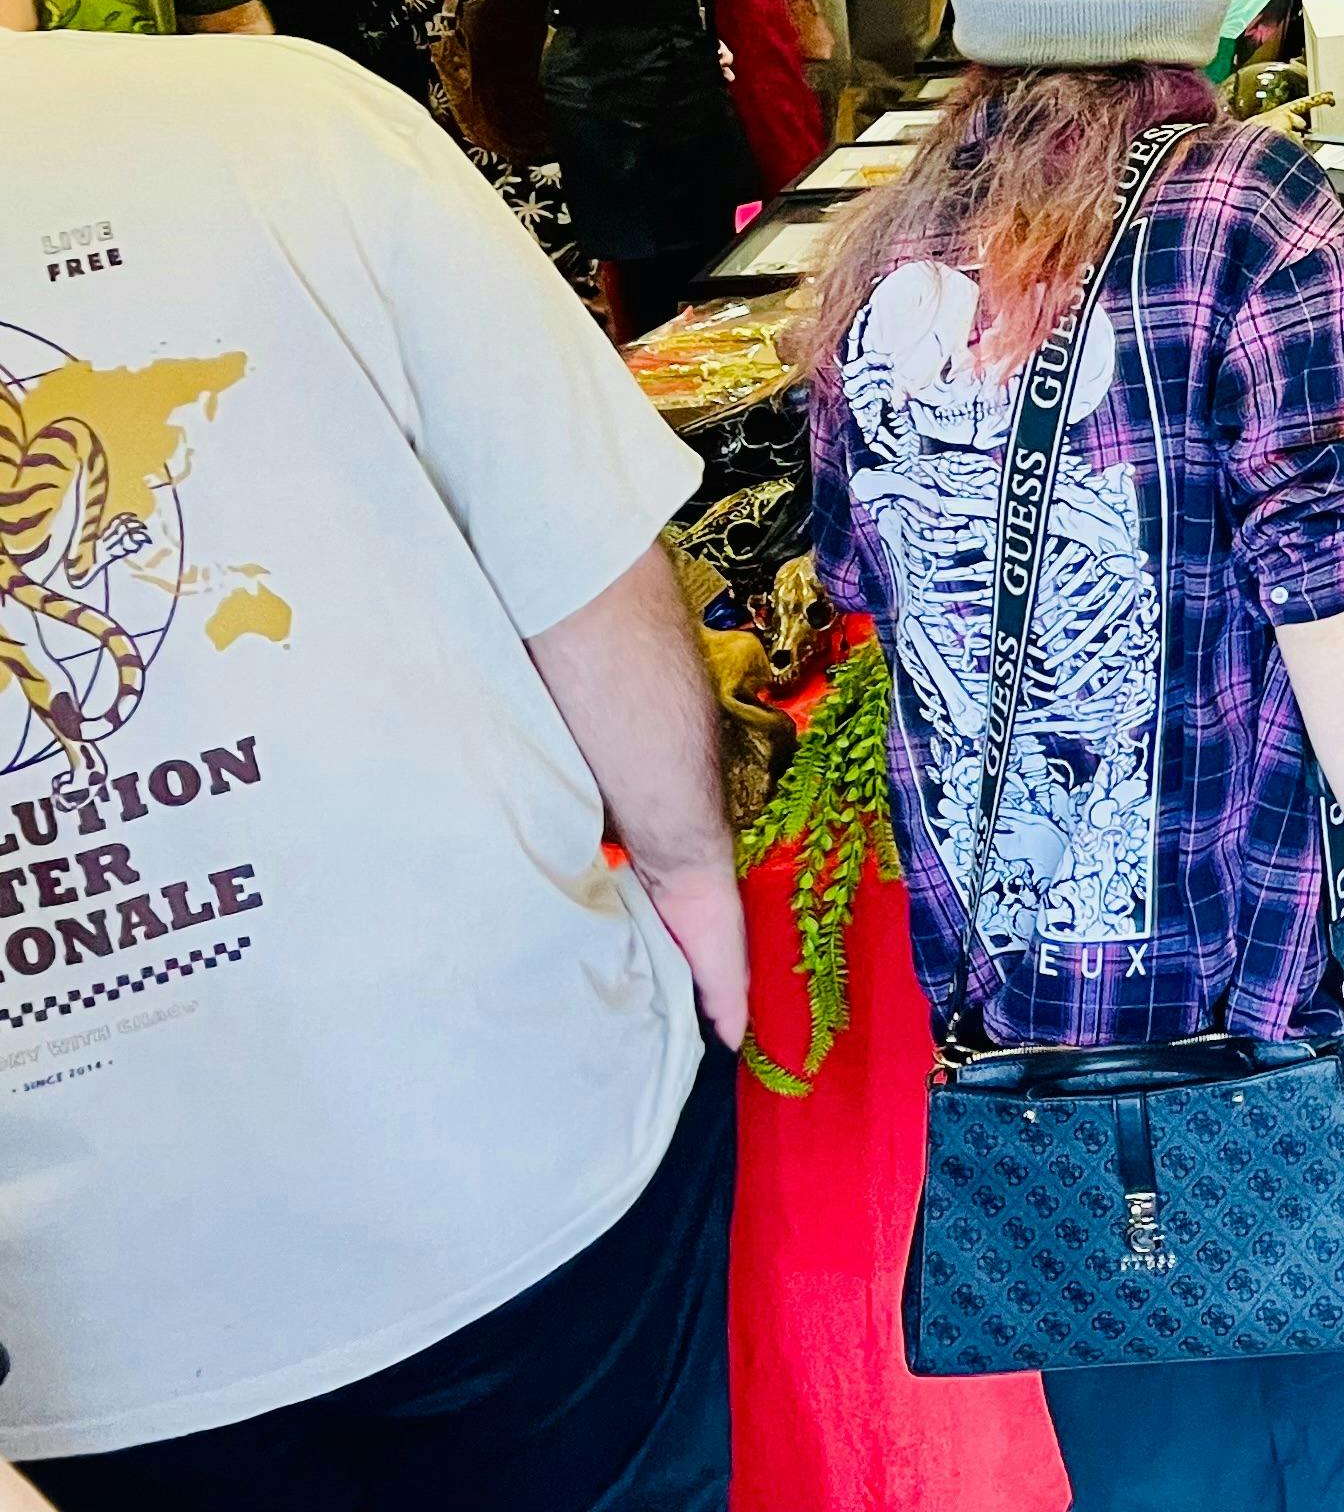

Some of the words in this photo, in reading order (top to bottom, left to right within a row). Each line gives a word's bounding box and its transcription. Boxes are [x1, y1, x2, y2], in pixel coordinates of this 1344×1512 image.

[42, 221, 114, 255] LIVE
[47, 248, 123, 282] FREE
[1002, 448, 1047, 596] GUESS
[985, 631, 1019, 778] GUESS
[24, 1071, 63, 1091] SINCE
